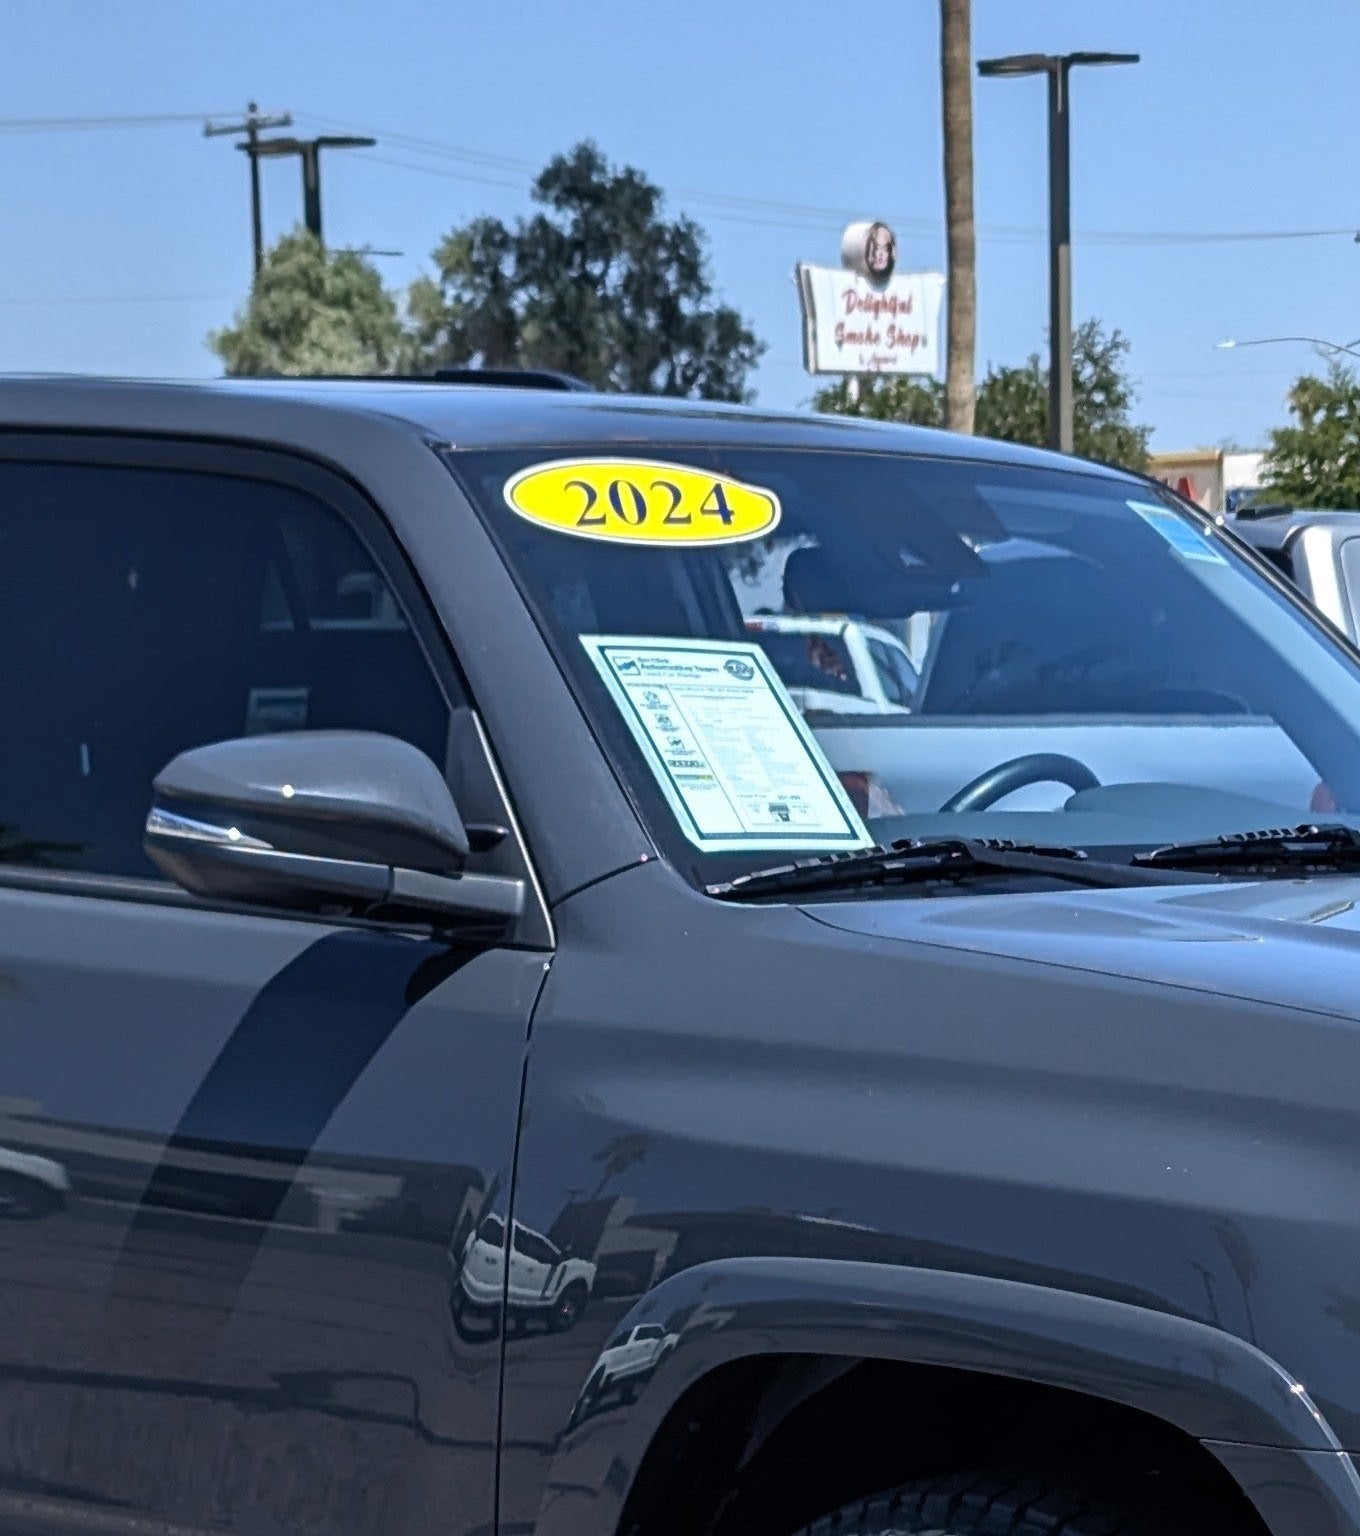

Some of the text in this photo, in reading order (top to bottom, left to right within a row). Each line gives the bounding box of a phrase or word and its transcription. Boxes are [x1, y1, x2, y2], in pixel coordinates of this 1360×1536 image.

[842, 289, 913, 320] Delightful
[835, 322, 919, 354] Smoke Shop
[563, 479, 736, 526] 2024
